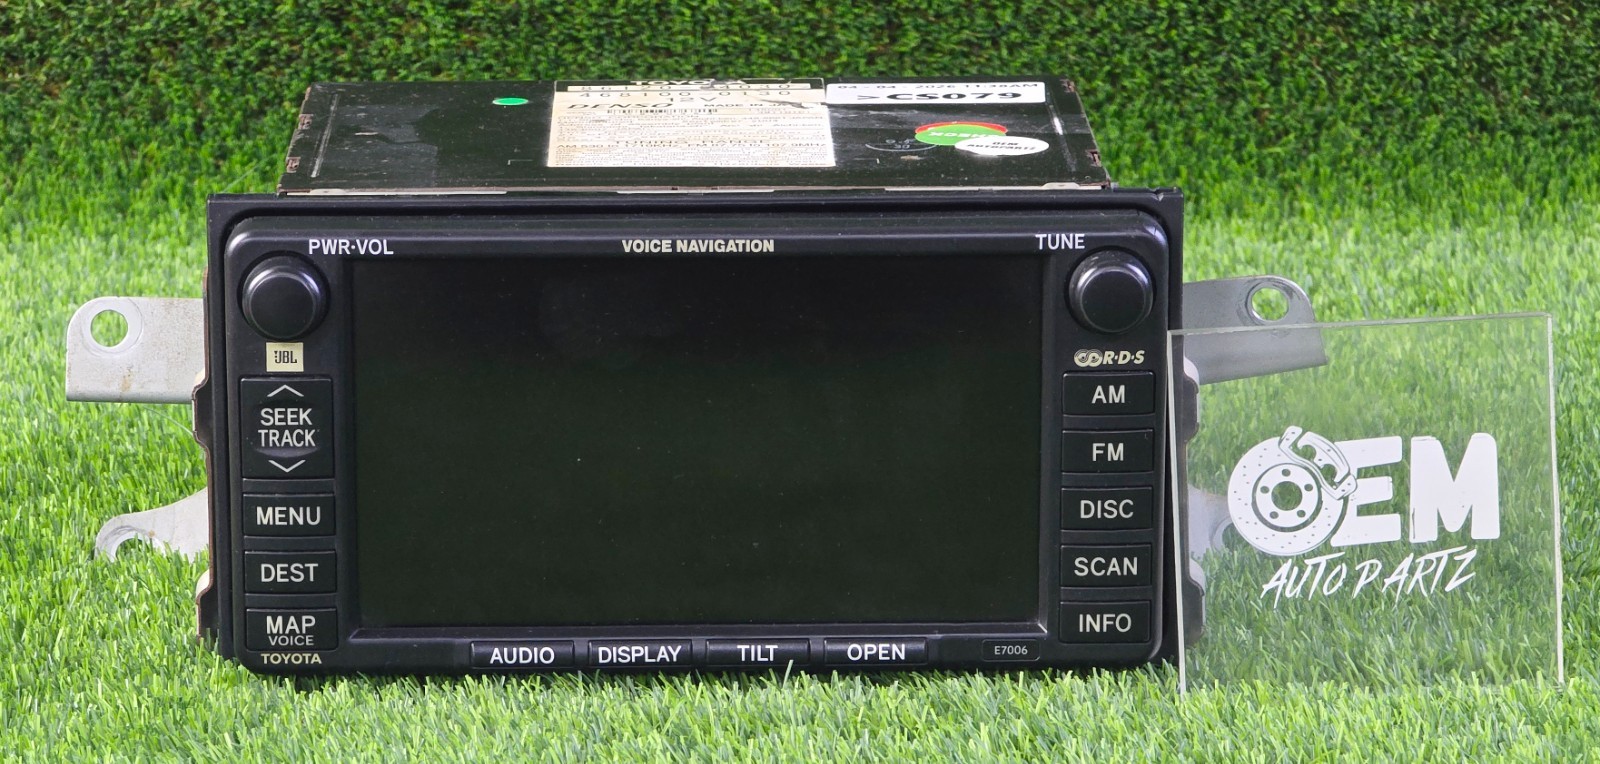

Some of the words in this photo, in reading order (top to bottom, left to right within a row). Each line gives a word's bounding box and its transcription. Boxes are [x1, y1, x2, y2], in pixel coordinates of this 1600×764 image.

[622, 239, 672, 252] VOICE
[676, 239, 775, 252] NAVIGATION
[1035, 233, 1086, 250] TUNE
[274, 350, 298, 364] JBL
[1091, 385, 1126, 404] AM
[260, 408, 313, 426] SEEK
[258, 429, 316, 447] TRACK
[1092, 443, 1124, 462] FM
[256, 506, 321, 526] MENU
[1080, 499, 1134, 519] DISC
[260, 563, 319, 582] DEST
[1074, 557, 1138, 576] SCAN
[1260, 552, 1346, 609] AUTO
[1353, 546, 1477, 609] PARTZ
[266, 616, 316, 635] MAP
[1079, 613, 1132, 633] INFO
[268, 635, 315, 646] VOICE
[261, 653, 322, 665] TOYOTA
[490, 646, 555, 664] AUDIO
[598, 645, 682, 663] DISPLAY
[737, 644, 778, 662] TILT
[846, 643, 906, 661] OPEN
[994, 645, 1028, 656] E7006
